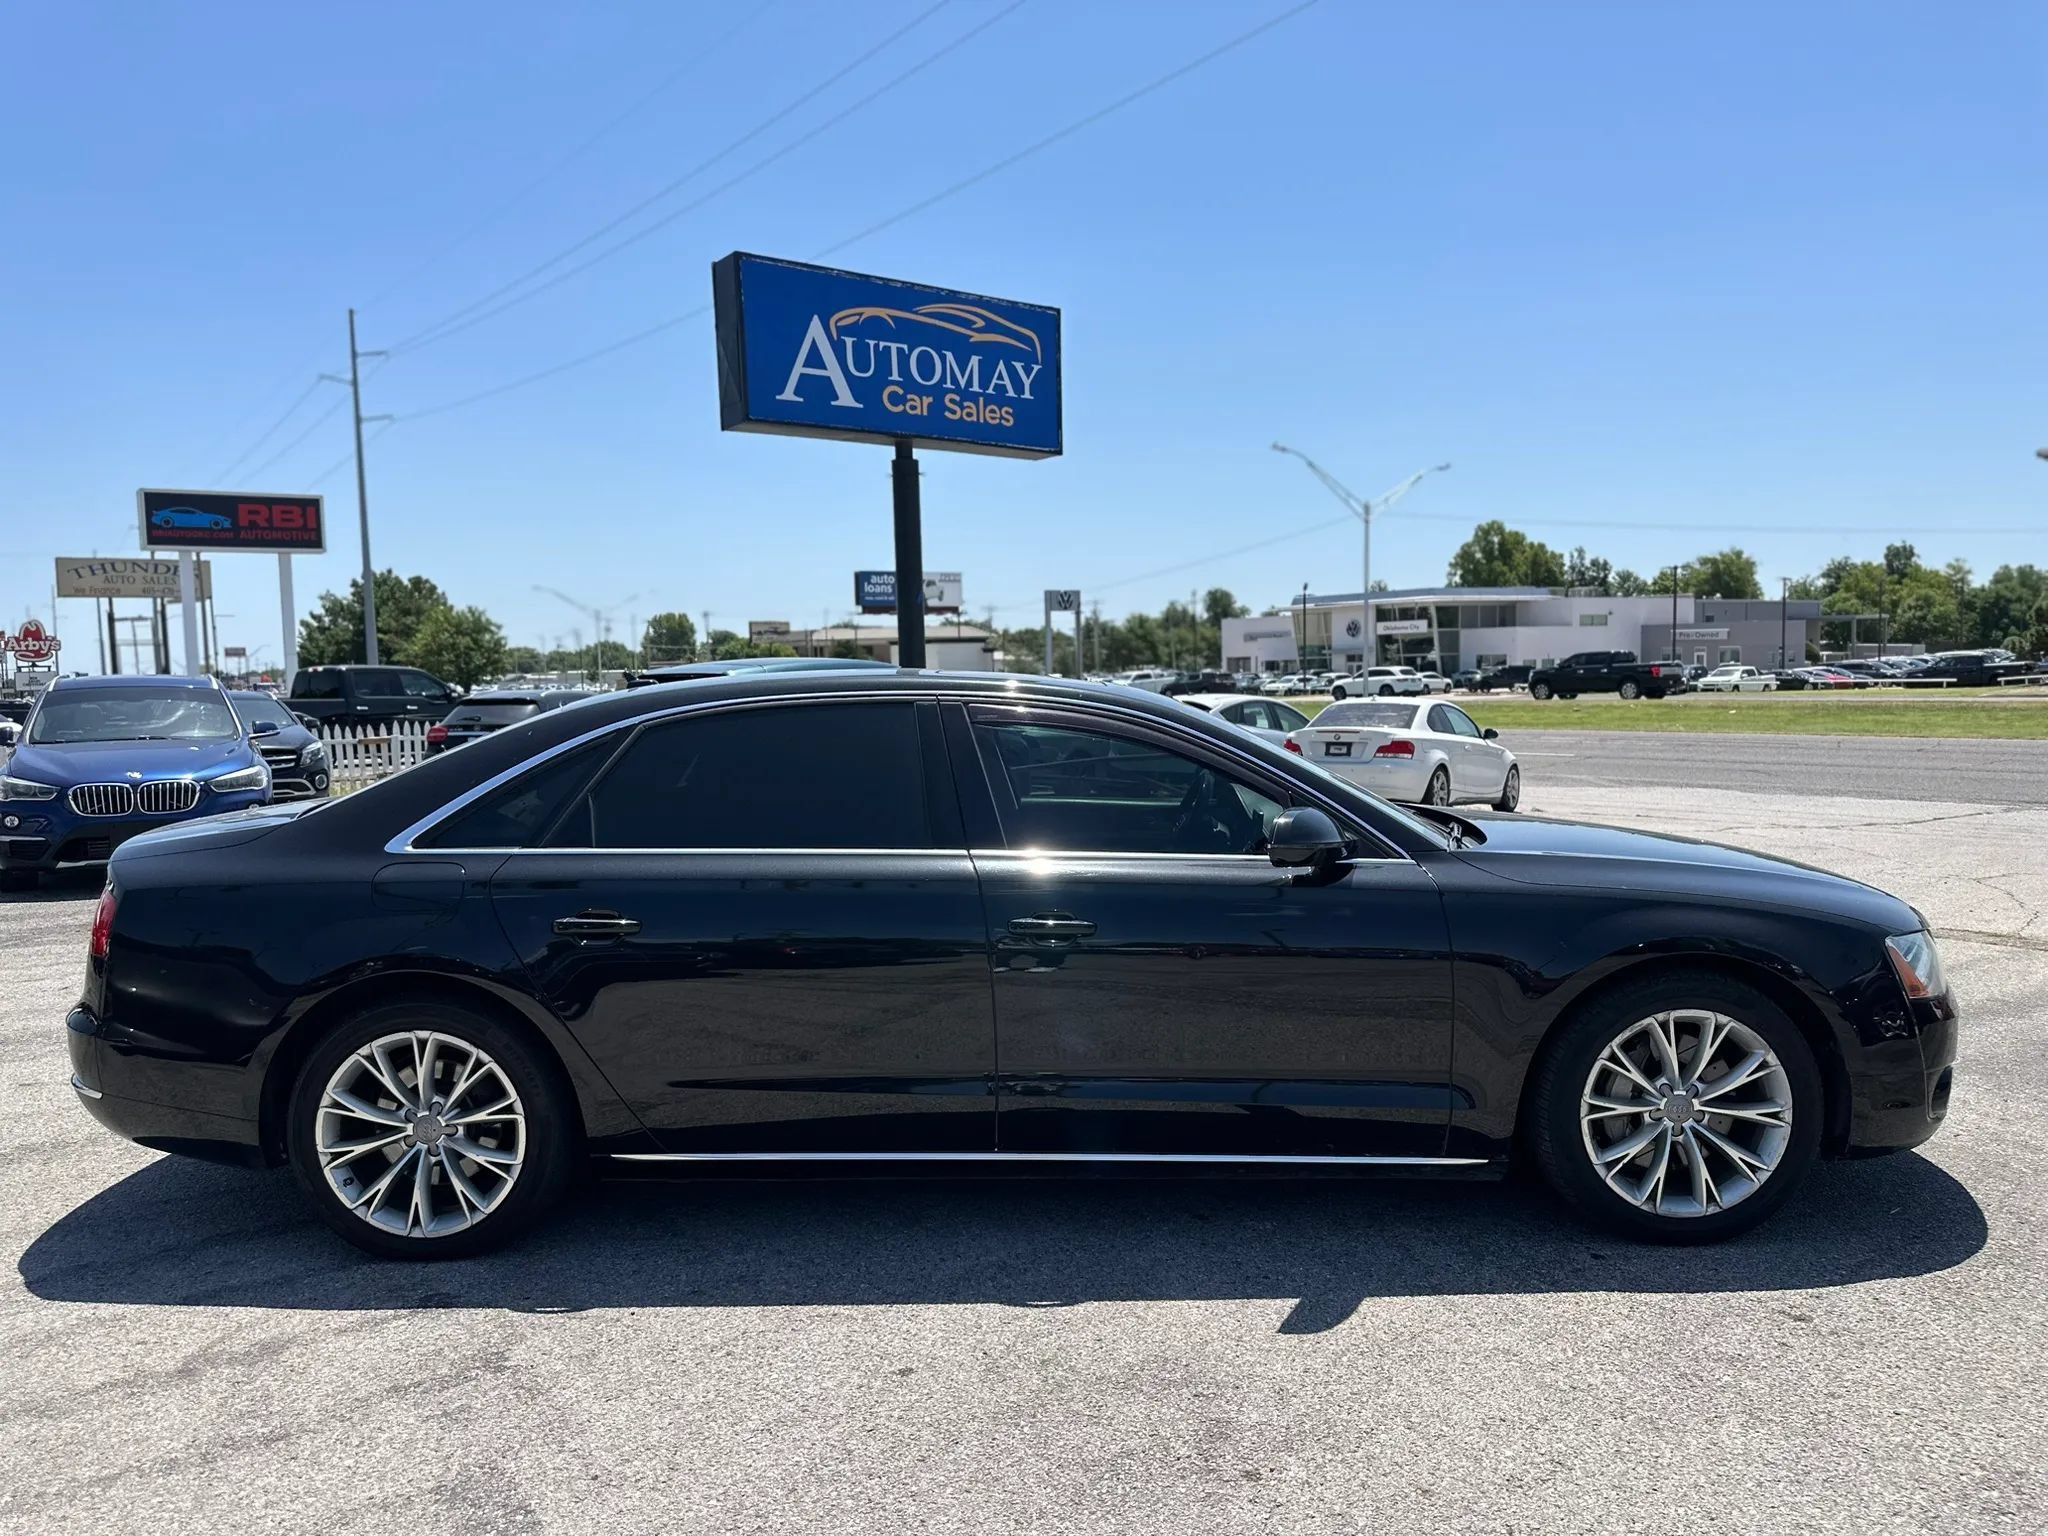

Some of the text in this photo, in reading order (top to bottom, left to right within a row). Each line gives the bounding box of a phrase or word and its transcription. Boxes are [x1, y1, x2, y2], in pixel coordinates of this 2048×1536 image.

[775, 314, 1042, 408] AUTOMAY
[882, 385, 1014, 427] Car Sales
[238, 503, 317, 529] RBI
[240, 530, 317, 542] AUTOMOTIVE
[103, 575, 177, 586] AUTO SALES
[870, 574, 895, 584] auto
[89, 586, 121, 596] Finance
[864, 582, 893, 593] loans
[1382, 623, 1420, 632] Oklahoma City
[6, 637, 60, 654] Arby's
